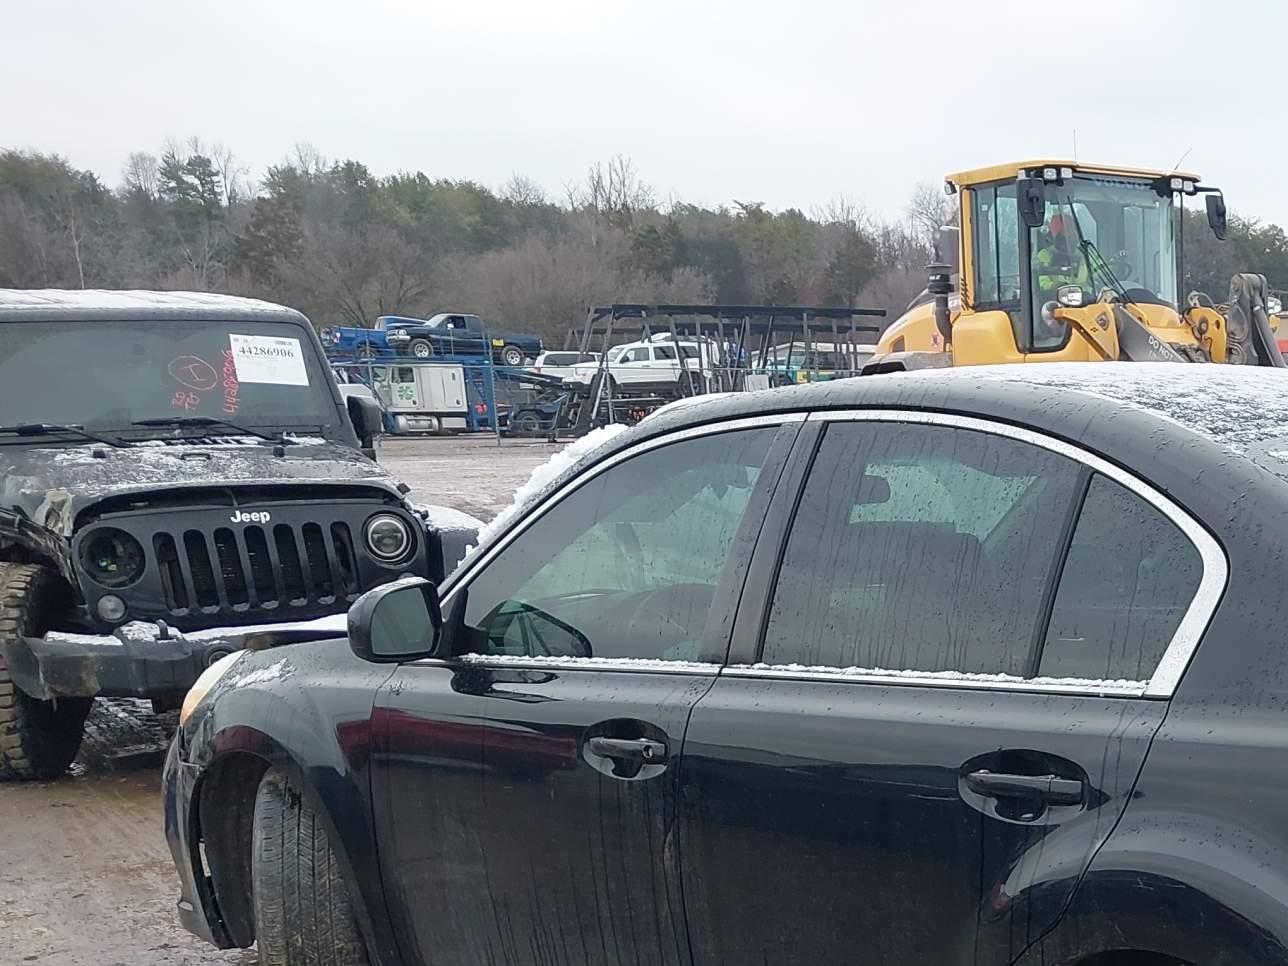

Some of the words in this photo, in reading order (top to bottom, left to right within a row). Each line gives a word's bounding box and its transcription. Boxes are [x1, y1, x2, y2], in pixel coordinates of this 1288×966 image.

[239, 345, 295, 358] 44286906
[1148, 335, 1159, 349] DO
[1158, 345, 1174, 361] NOT
[230, 510, 271, 524] Jeep
